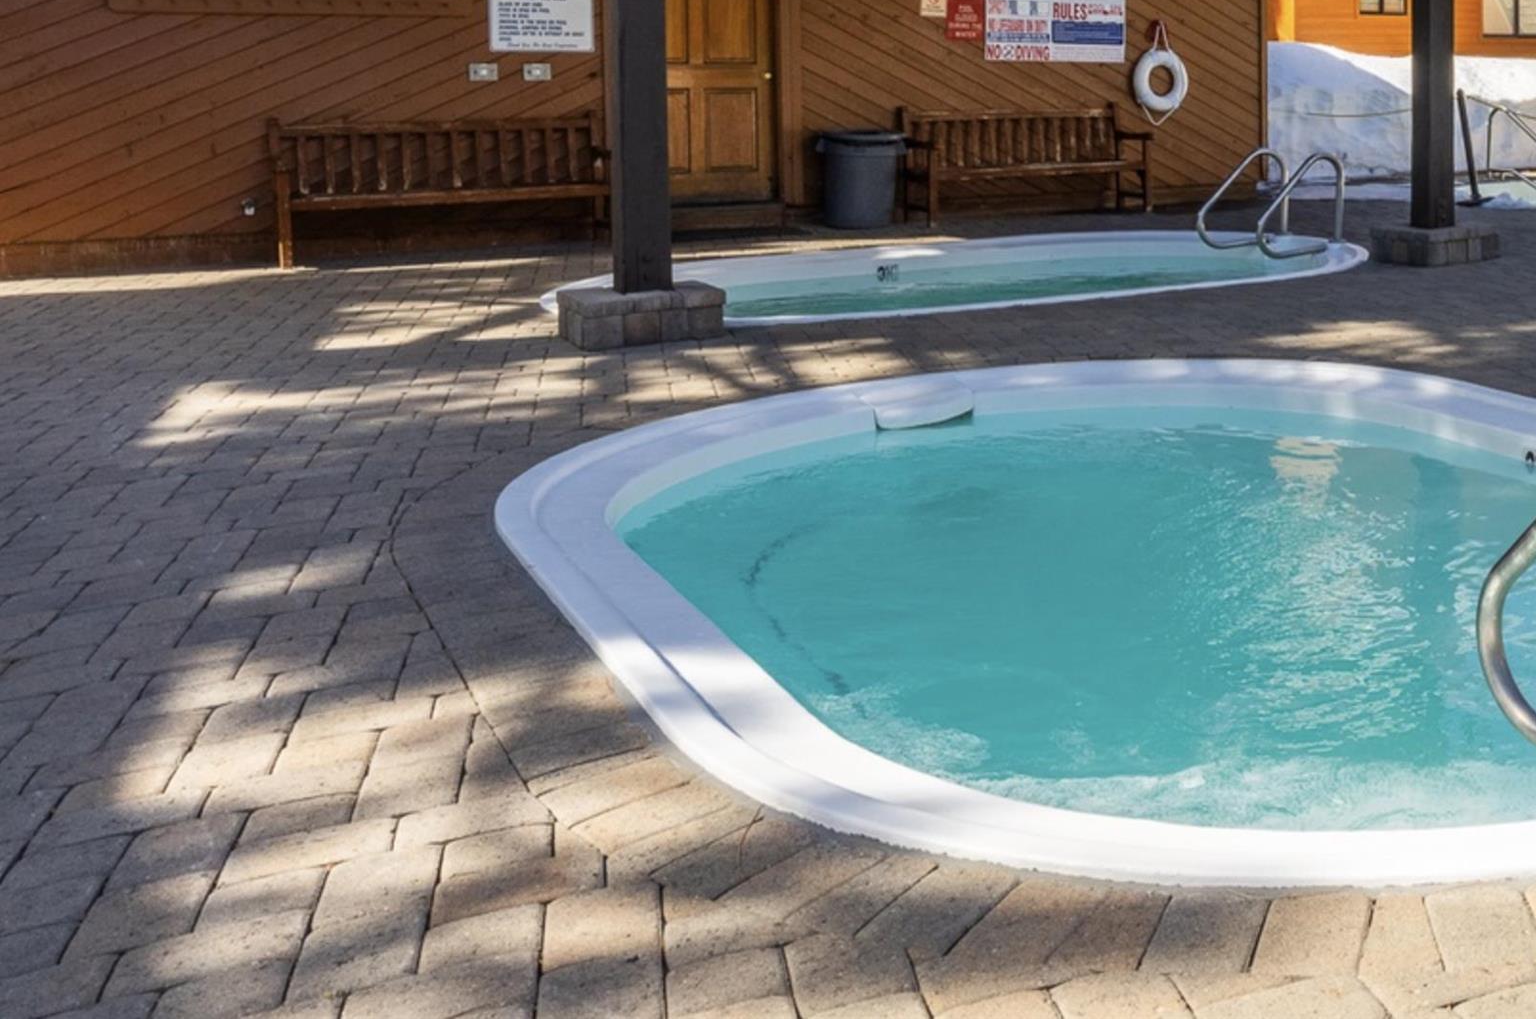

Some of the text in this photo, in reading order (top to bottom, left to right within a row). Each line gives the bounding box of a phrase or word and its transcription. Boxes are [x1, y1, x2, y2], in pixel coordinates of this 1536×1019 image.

[1053, 2, 1088, 20] RULES
[986, 44, 1001, 60] NO
[1015, 45, 1050, 61] DIVING
